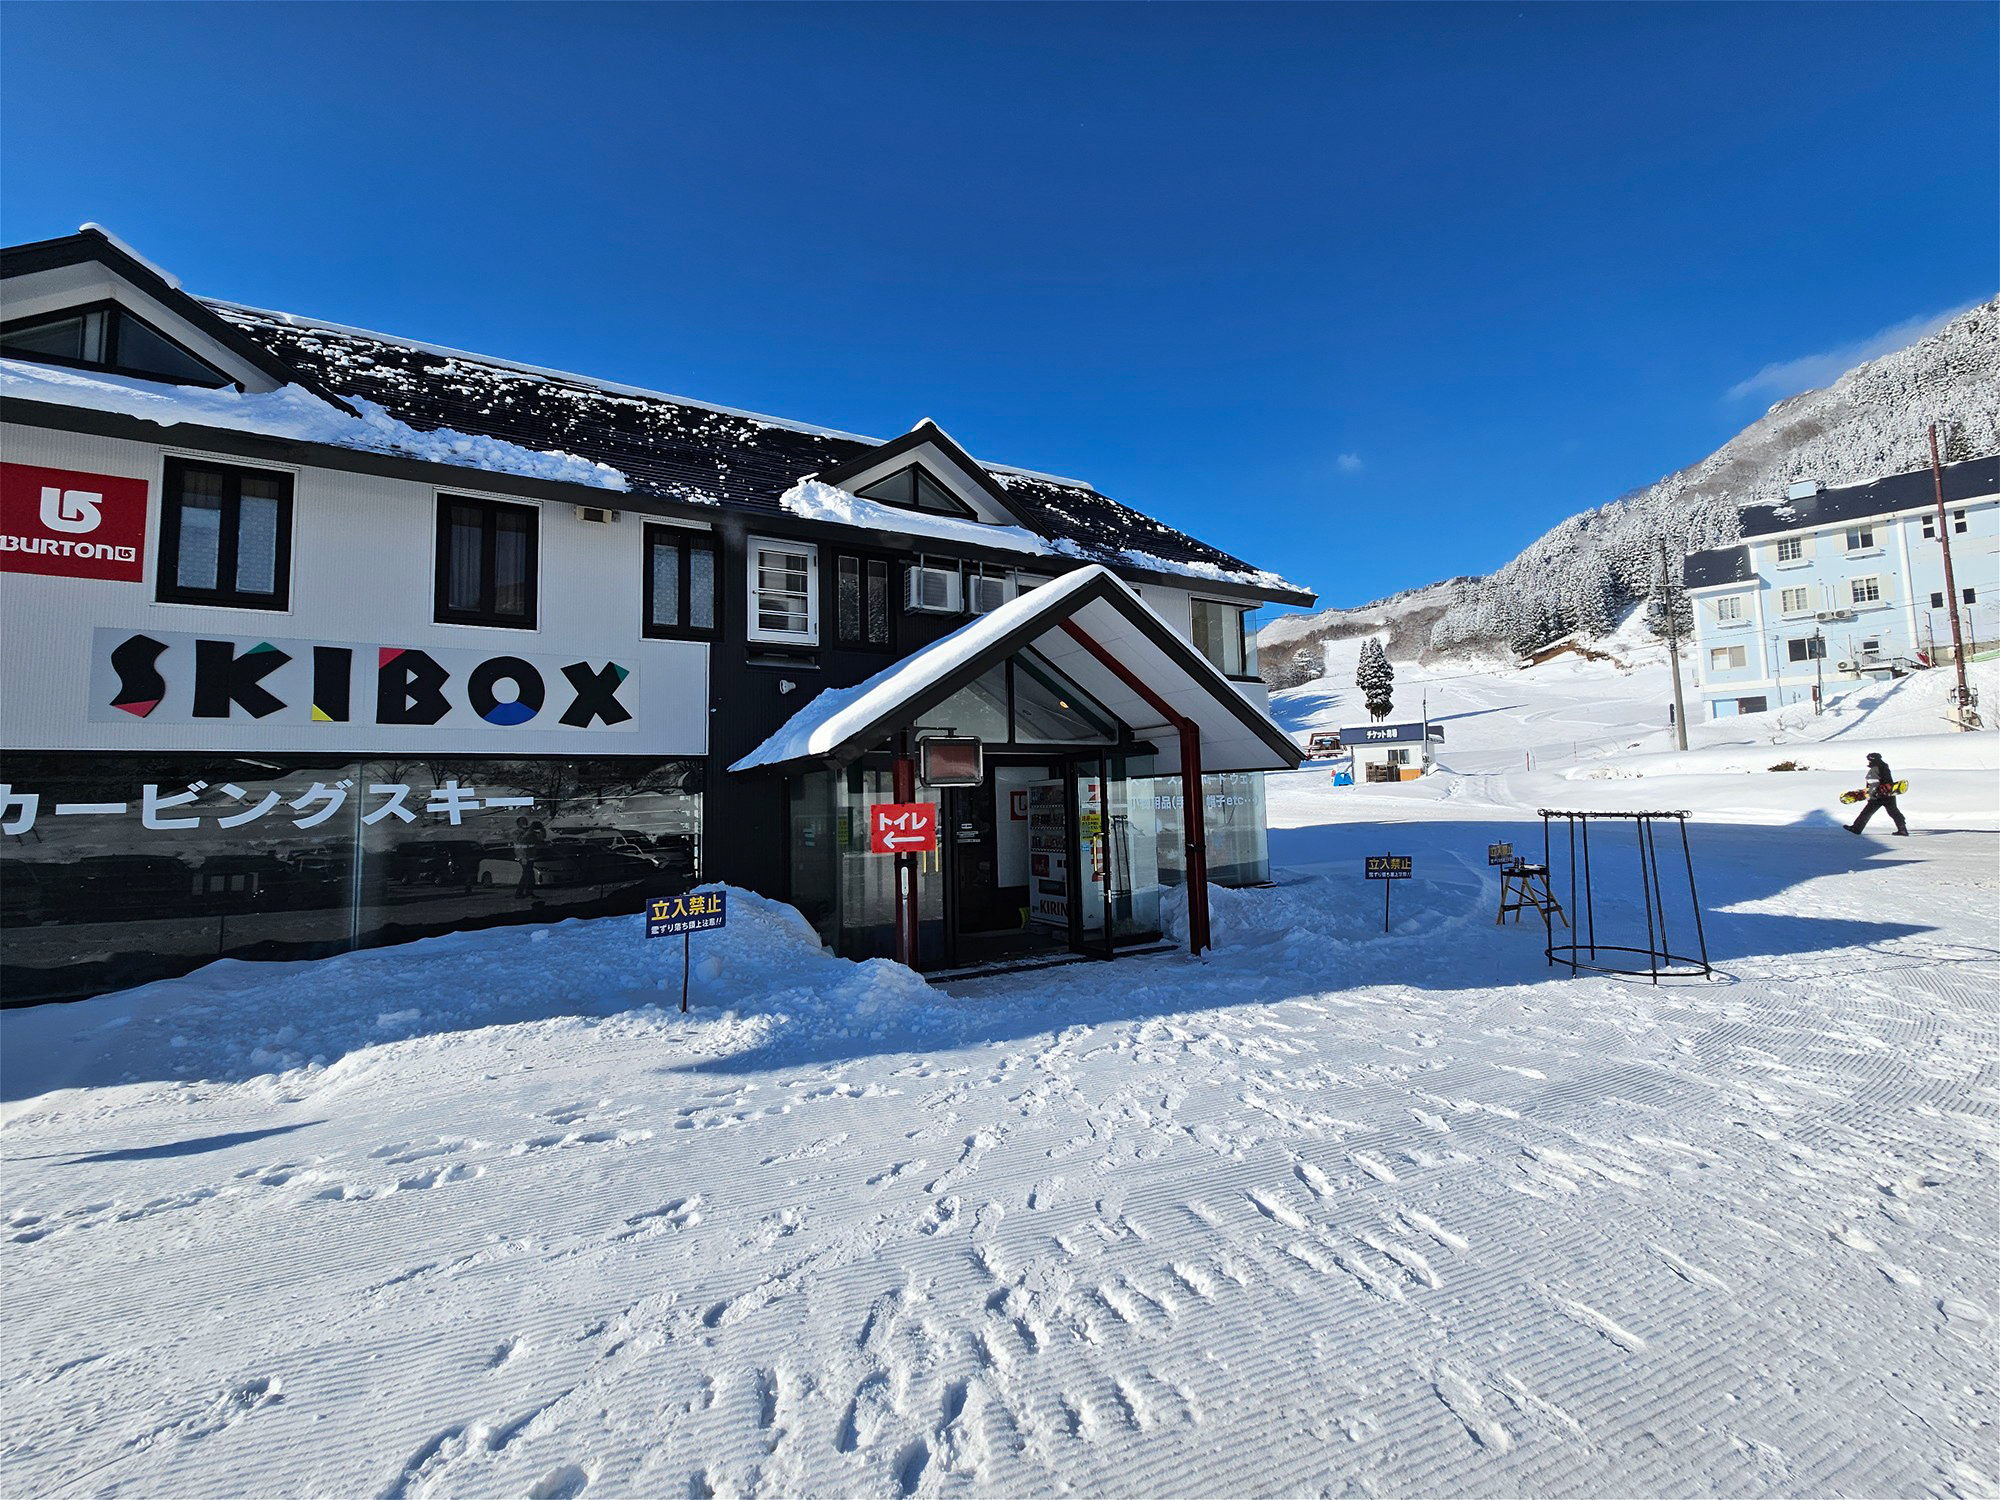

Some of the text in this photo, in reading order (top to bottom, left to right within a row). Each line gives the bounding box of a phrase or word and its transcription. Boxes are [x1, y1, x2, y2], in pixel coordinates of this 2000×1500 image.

[0, 534, 115, 561] BURTON
[109, 634, 633, 729] SKIBOX
[0, 779, 535, 836] カービングスキー
[879, 812, 928, 831] トイレ
[1368, 858, 1412, 870] 立入禁止
[651, 894, 722, 921] 立入禁止
